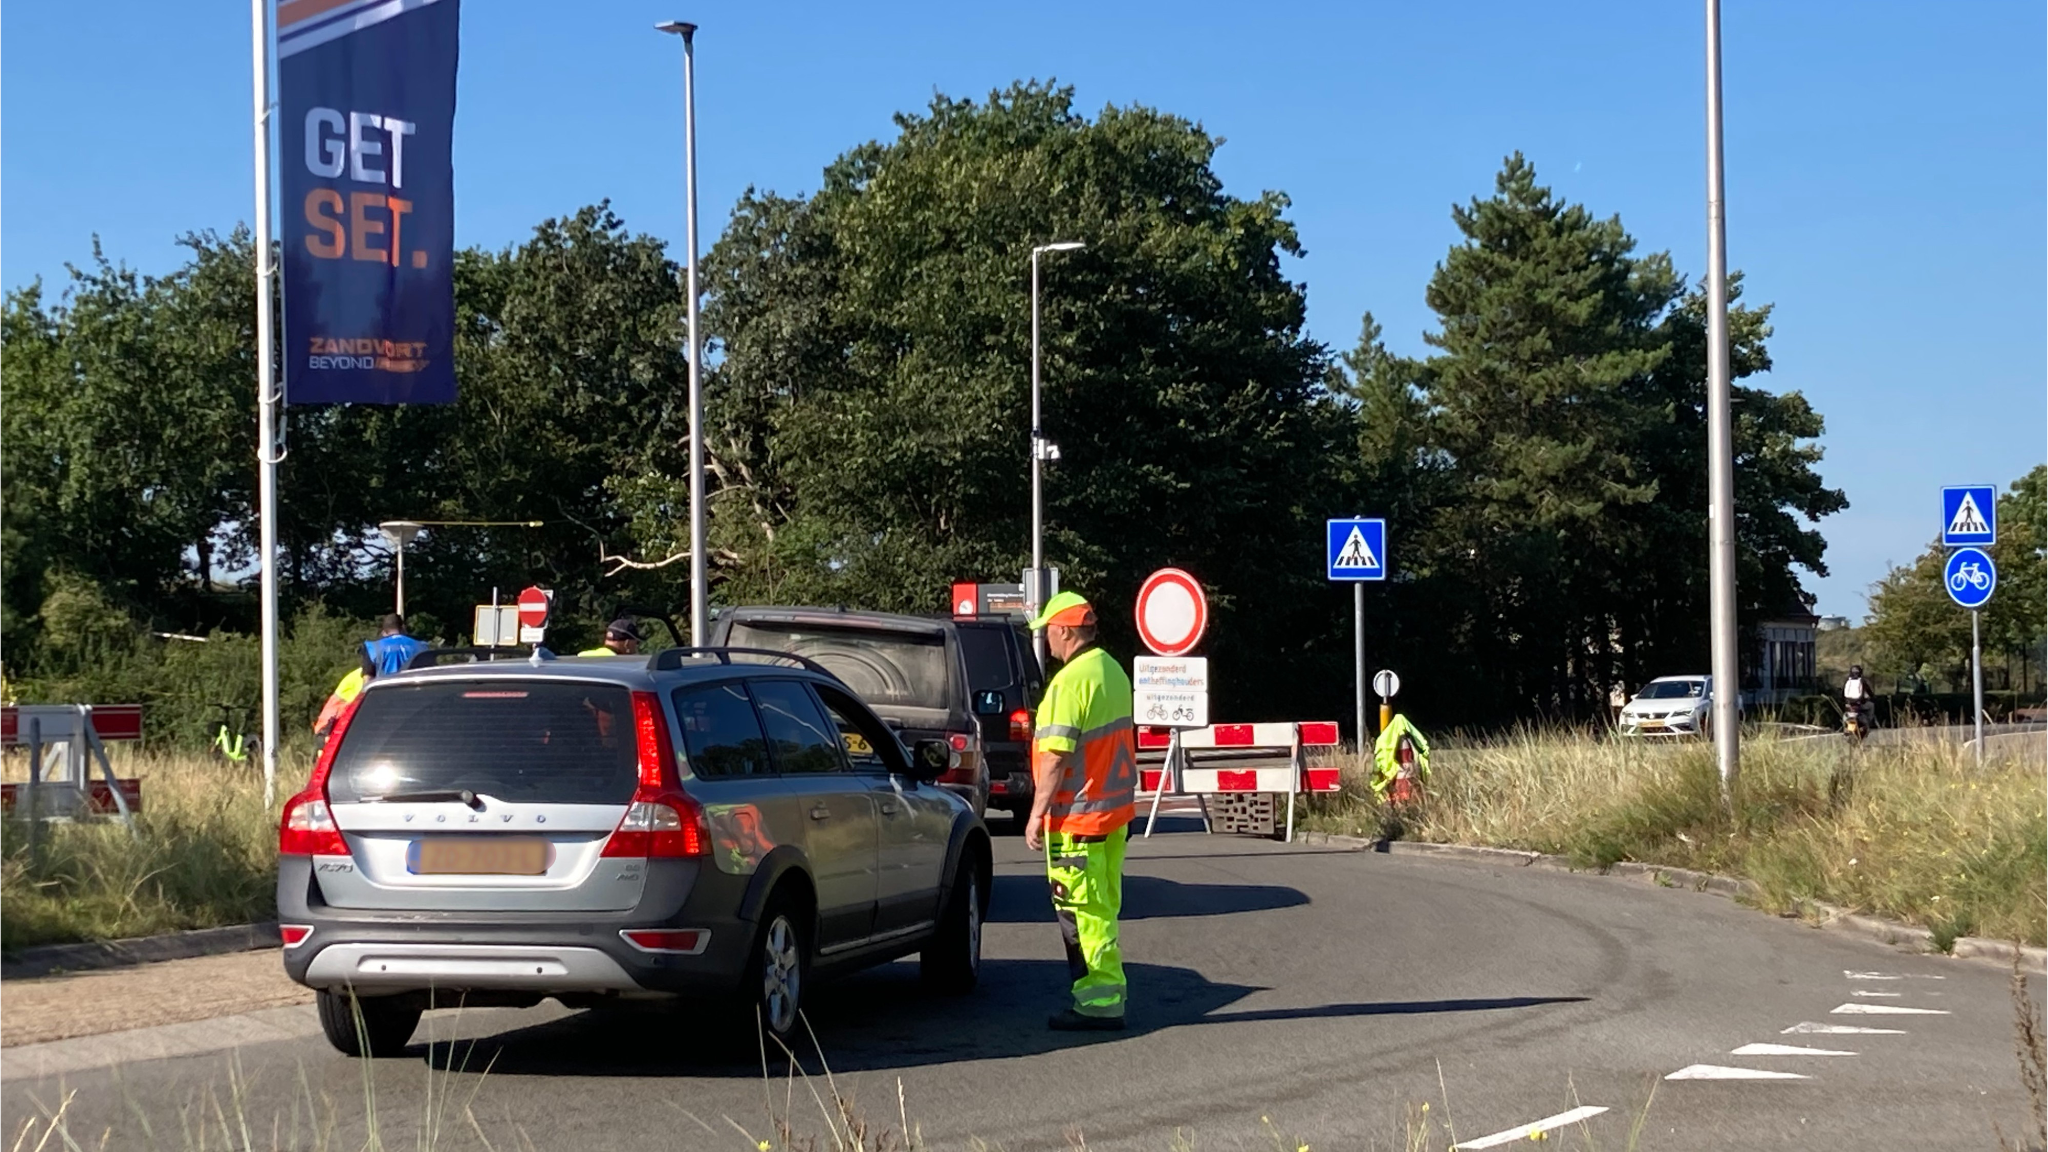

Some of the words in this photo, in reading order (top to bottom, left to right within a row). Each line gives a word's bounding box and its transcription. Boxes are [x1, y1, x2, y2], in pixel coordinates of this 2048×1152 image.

[304, 106, 416, 188] GET
[304, 188, 428, 269] SET.
[309, 355, 375, 369] BEYOND
[1138, 664, 1187, 675] Uitgezonderd
[403, 814, 547, 824] VOLVO
